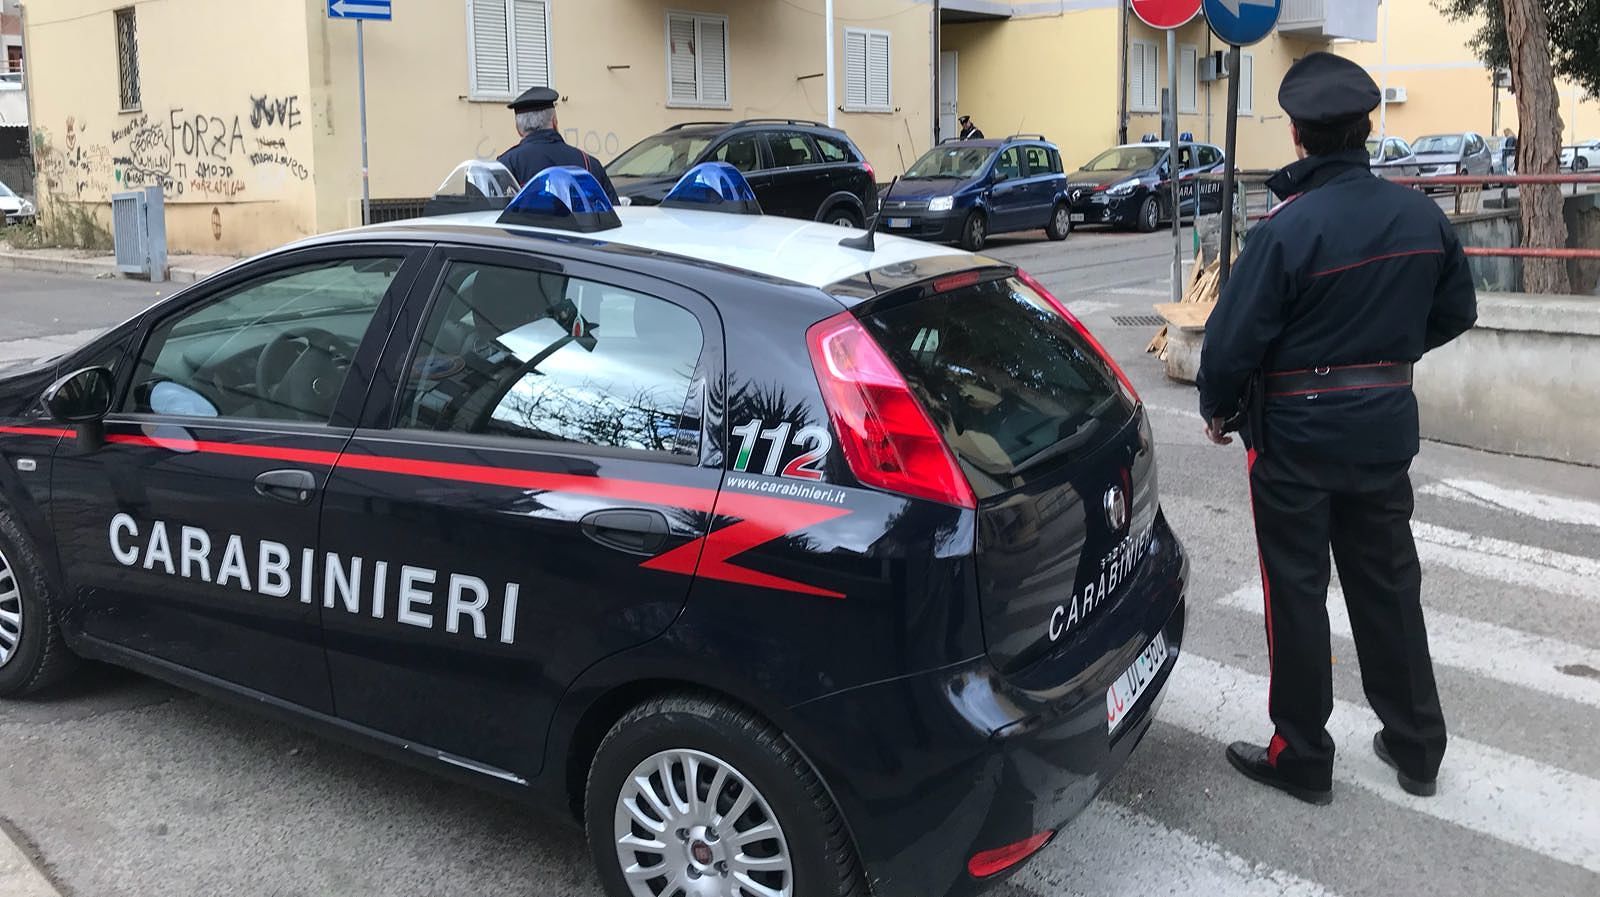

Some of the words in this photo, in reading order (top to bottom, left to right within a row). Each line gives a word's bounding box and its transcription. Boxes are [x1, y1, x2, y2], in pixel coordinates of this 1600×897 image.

[170, 108, 246, 161] FORZA
[1179, 182, 1220, 197] ARANIERI
[731, 418, 832, 481] 112
[726, 476, 846, 504] www.carabinieri.it
[108, 512, 520, 645] CARABINIERI
